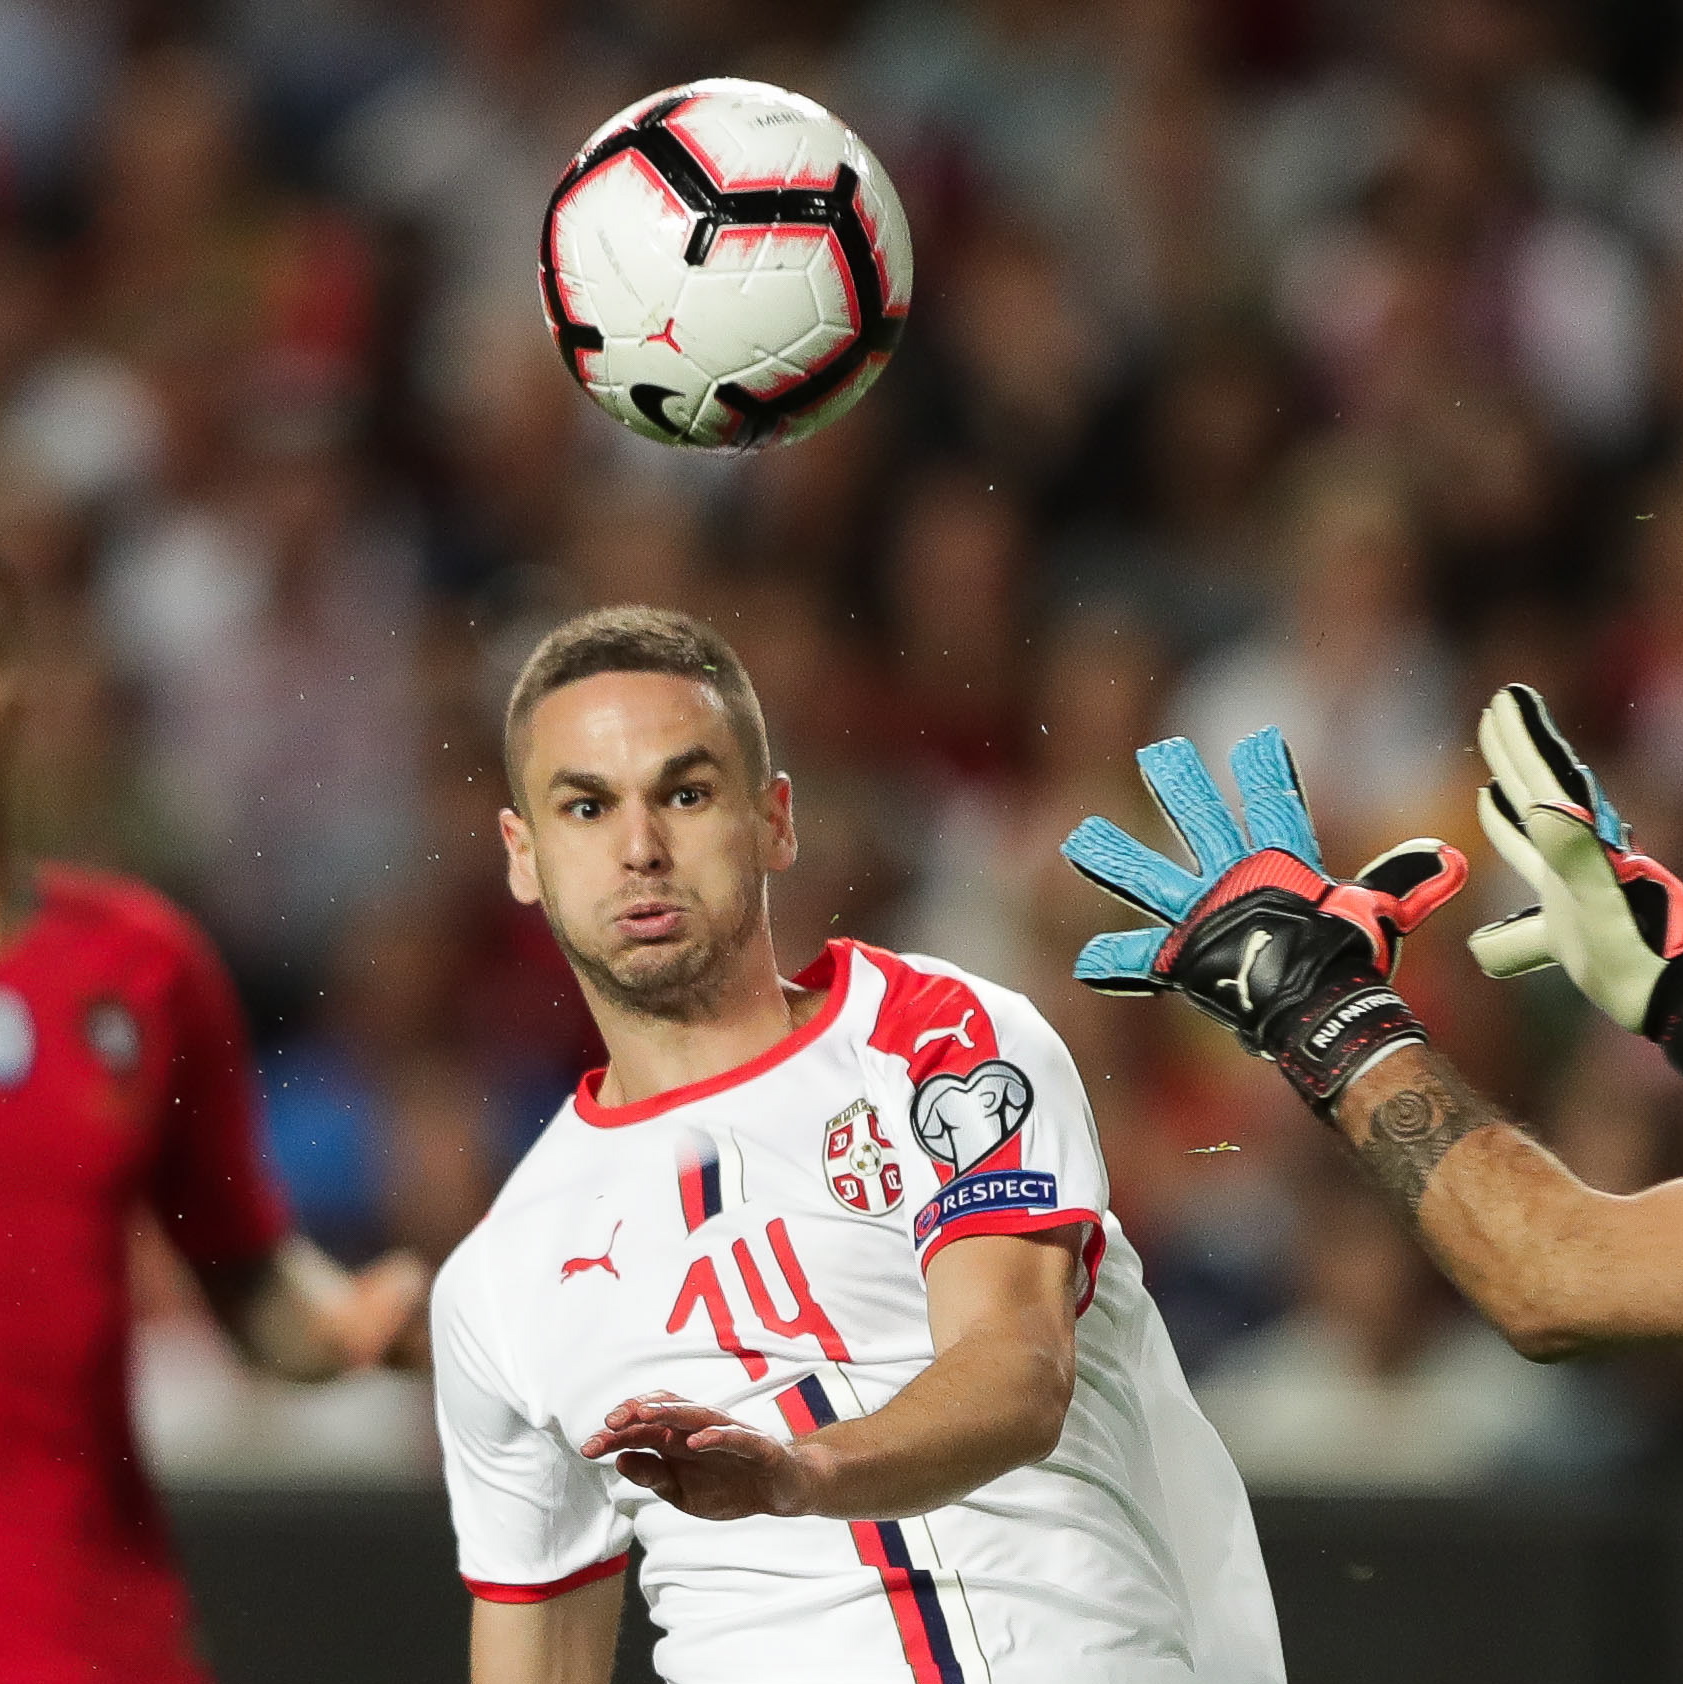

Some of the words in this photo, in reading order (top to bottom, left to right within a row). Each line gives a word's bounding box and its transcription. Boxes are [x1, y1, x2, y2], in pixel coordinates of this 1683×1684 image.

[1311, 1018, 1346, 1049] RUI
[942, 1179, 1054, 1214] RESPECT
[665, 1216, 852, 1383] 14
